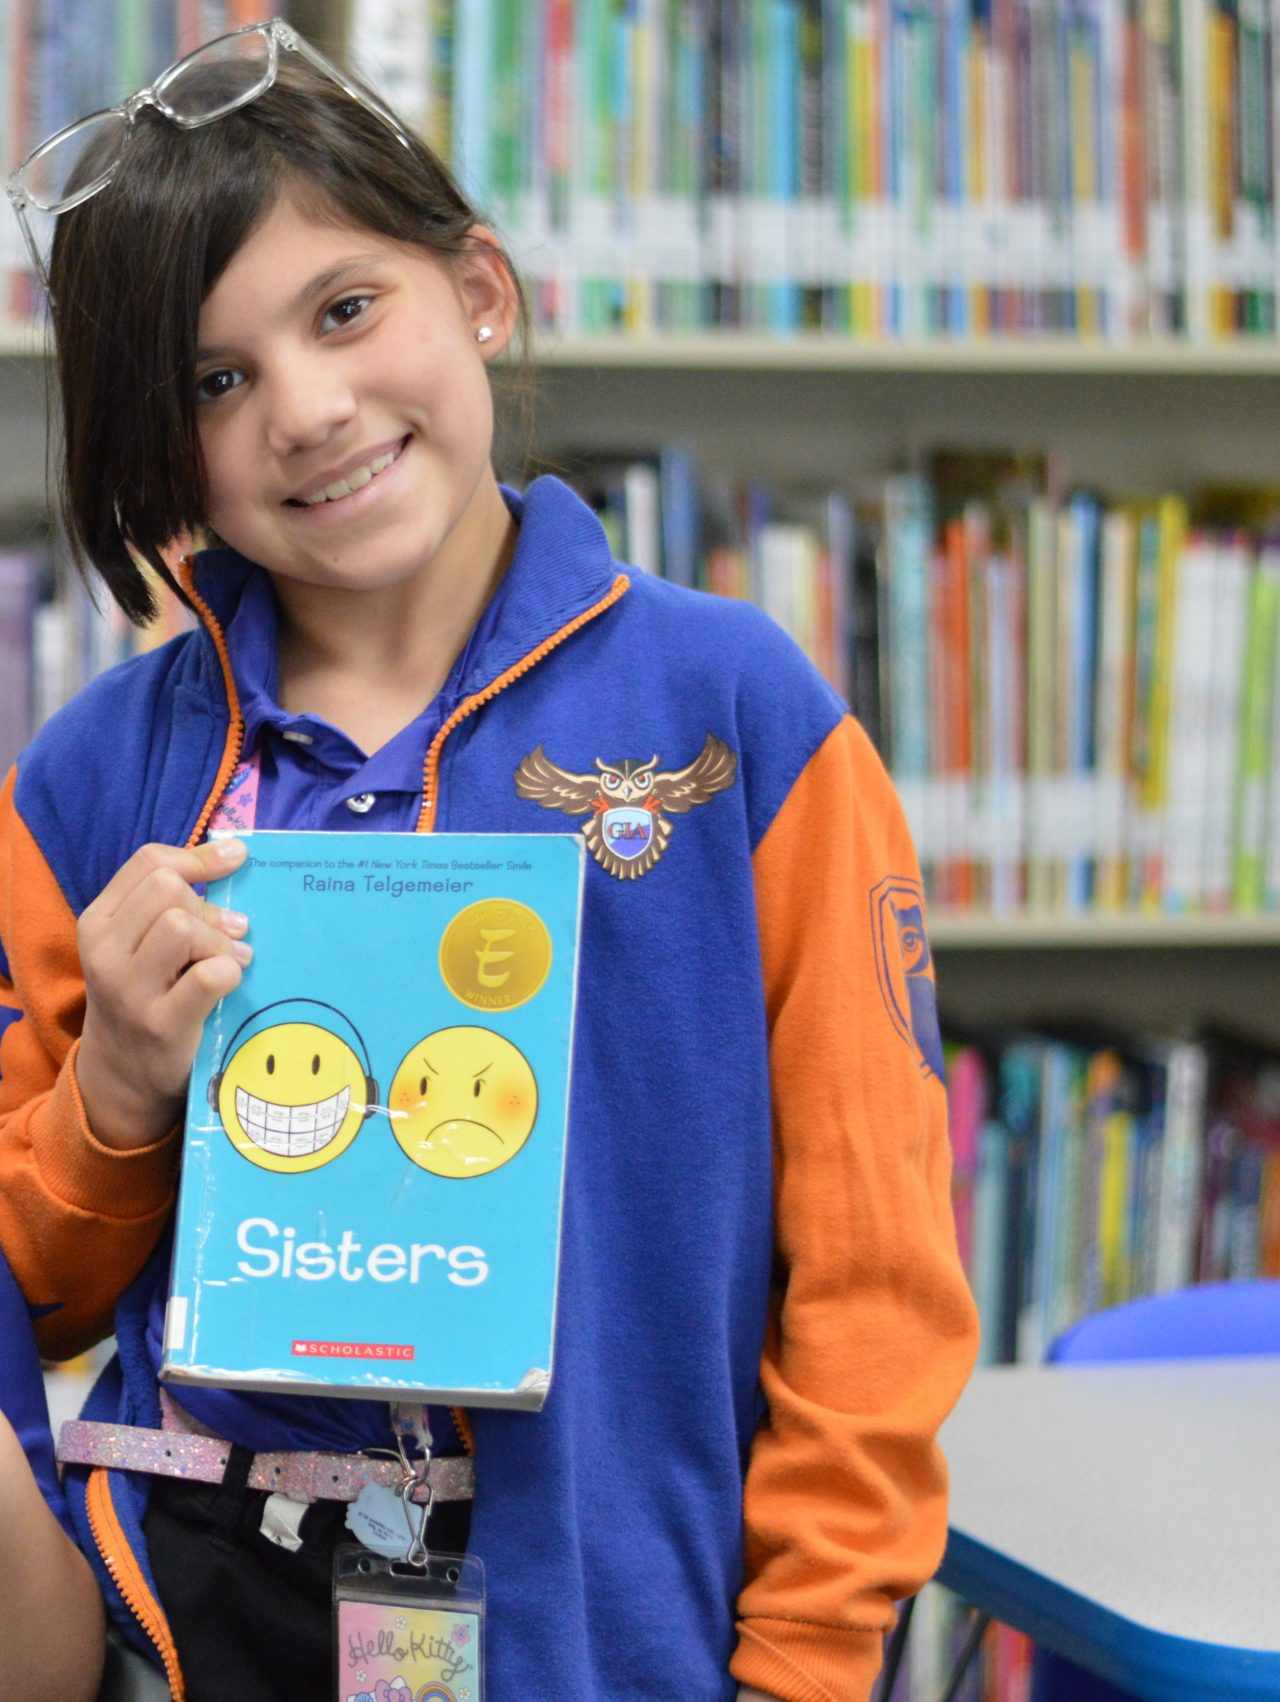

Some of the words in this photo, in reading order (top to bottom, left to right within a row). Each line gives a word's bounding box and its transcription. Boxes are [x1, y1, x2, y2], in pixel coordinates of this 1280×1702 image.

[607, 822, 647, 840] GIA
[248, 857, 267, 868] The
[269, 859, 322, 871] companion
[324, 859, 335, 869] to
[338, 858, 355, 869] the
[357, 859, 369, 869] #1
[370, 859, 392, 869] New
[395, 859, 418, 870] York
[421, 859, 449, 870] Times
[450, 860, 503, 871] Bestseller
[506, 860, 532, 871] Smile
[303, 874, 355, 892] Raina
[363, 874, 474, 898] Telgemeier
[465, 988, 512, 1006] WINNER
[236, 1217, 490, 1287] Sisters
[309, 1344, 412, 1358] SCHOLASTIC
[348, 1629, 409, 1668] Hello
[410, 1630, 470, 1683] Kitty
